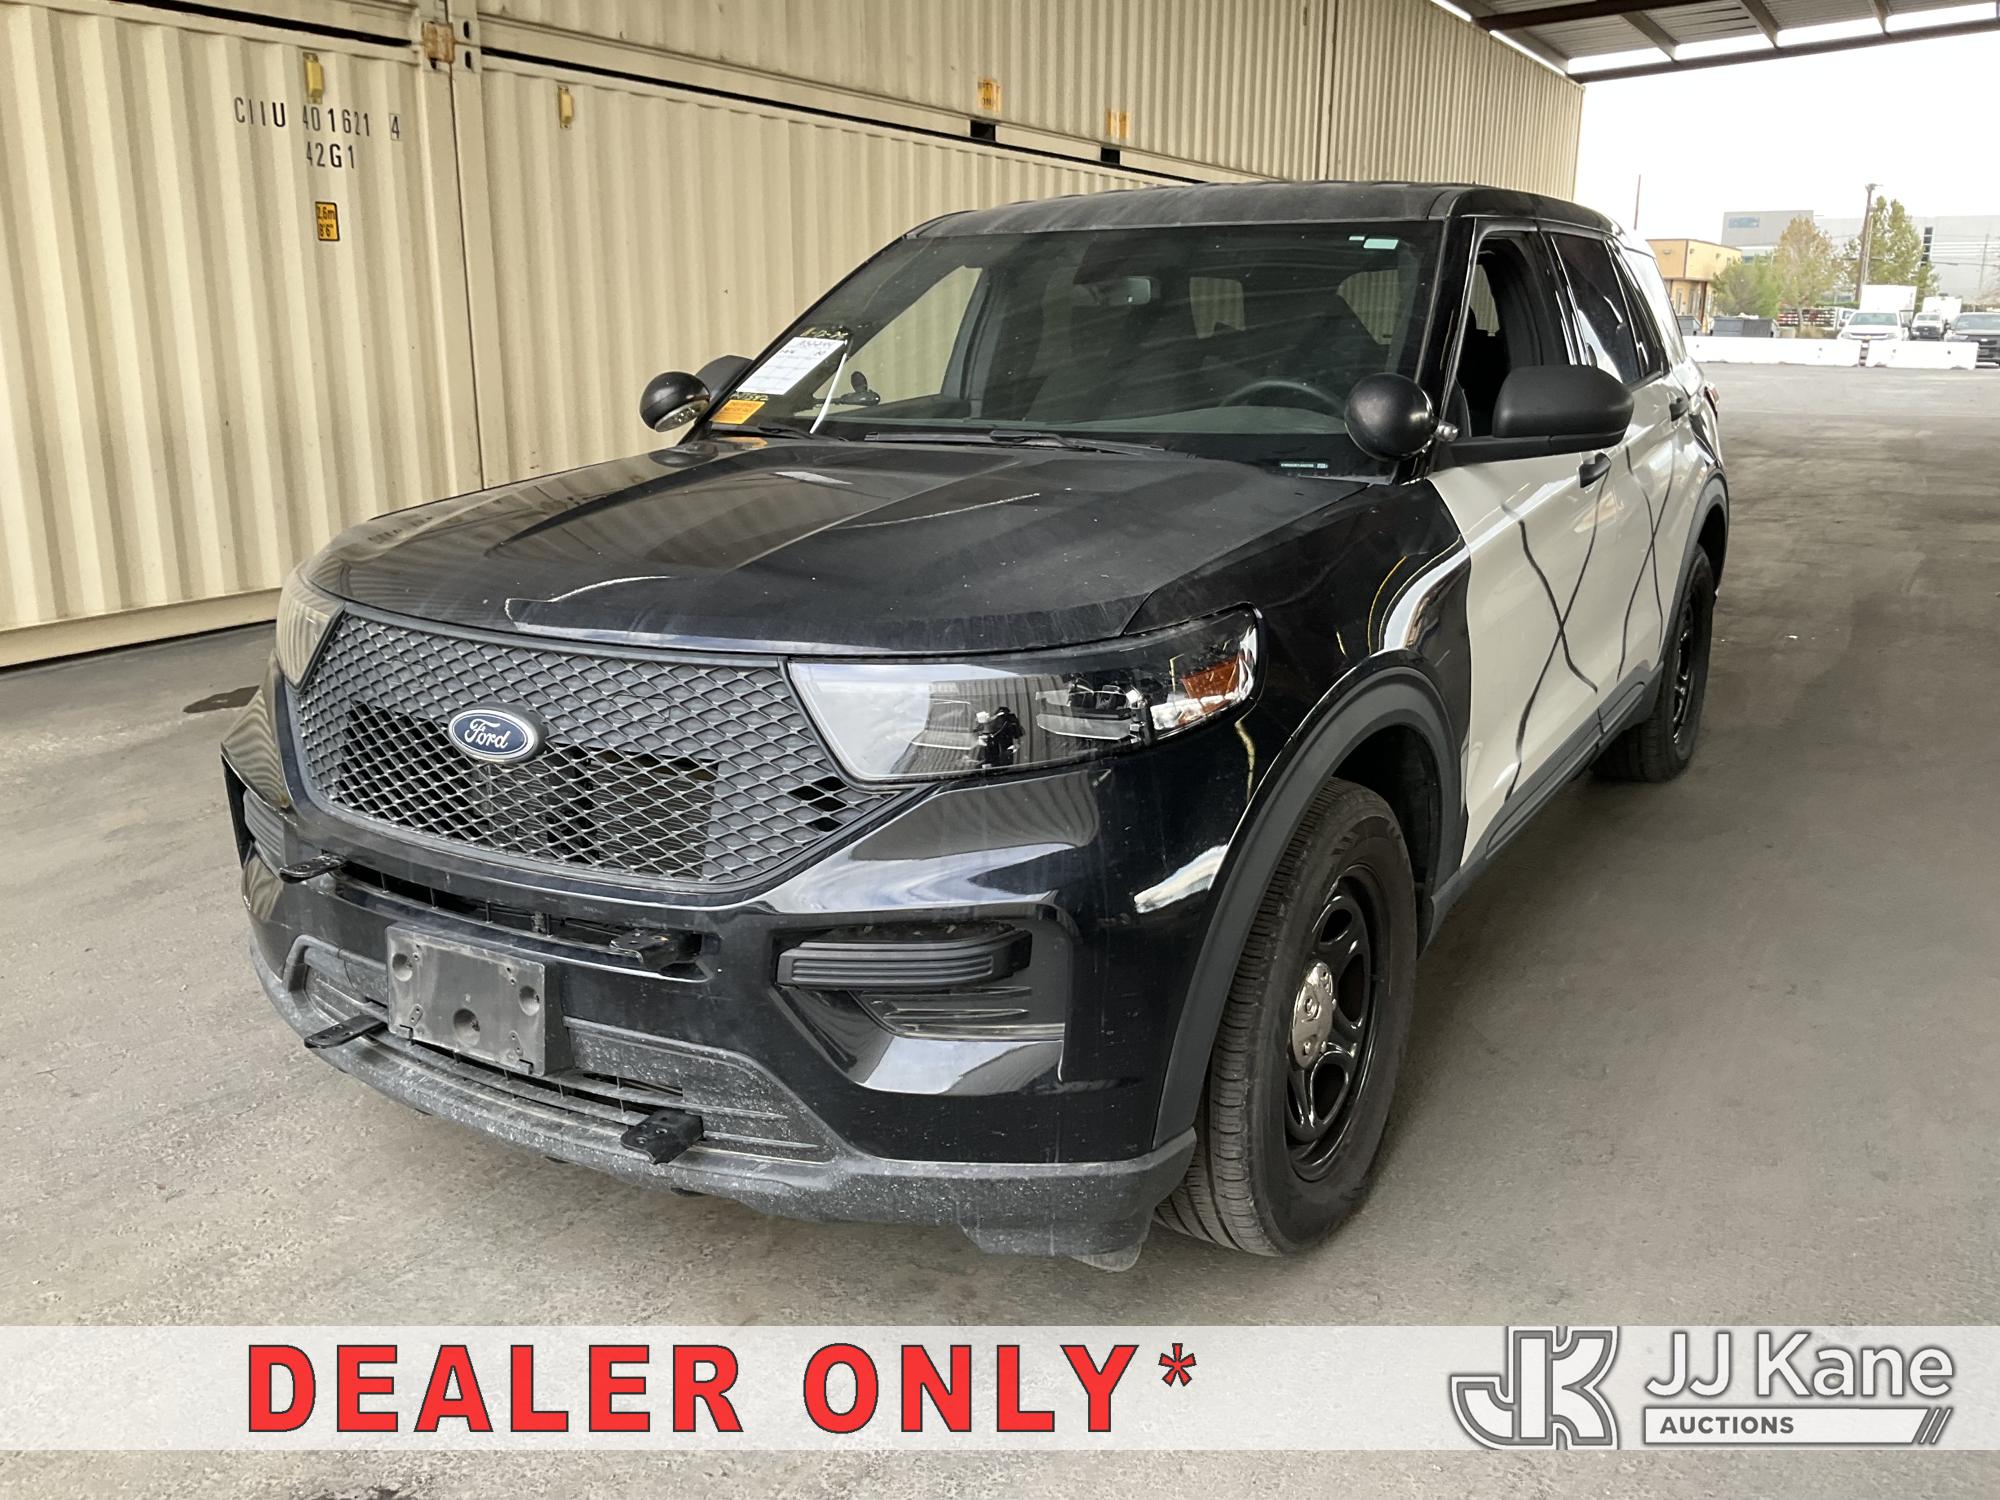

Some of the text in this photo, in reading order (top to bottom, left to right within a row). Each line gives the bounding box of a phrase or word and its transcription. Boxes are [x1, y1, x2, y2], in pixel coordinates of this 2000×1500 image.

[303, 105, 370, 137] 401621
[391, 115, 400, 139] 4
[306, 141, 355, 169] 42G1
[464, 718, 512, 749] Ford
